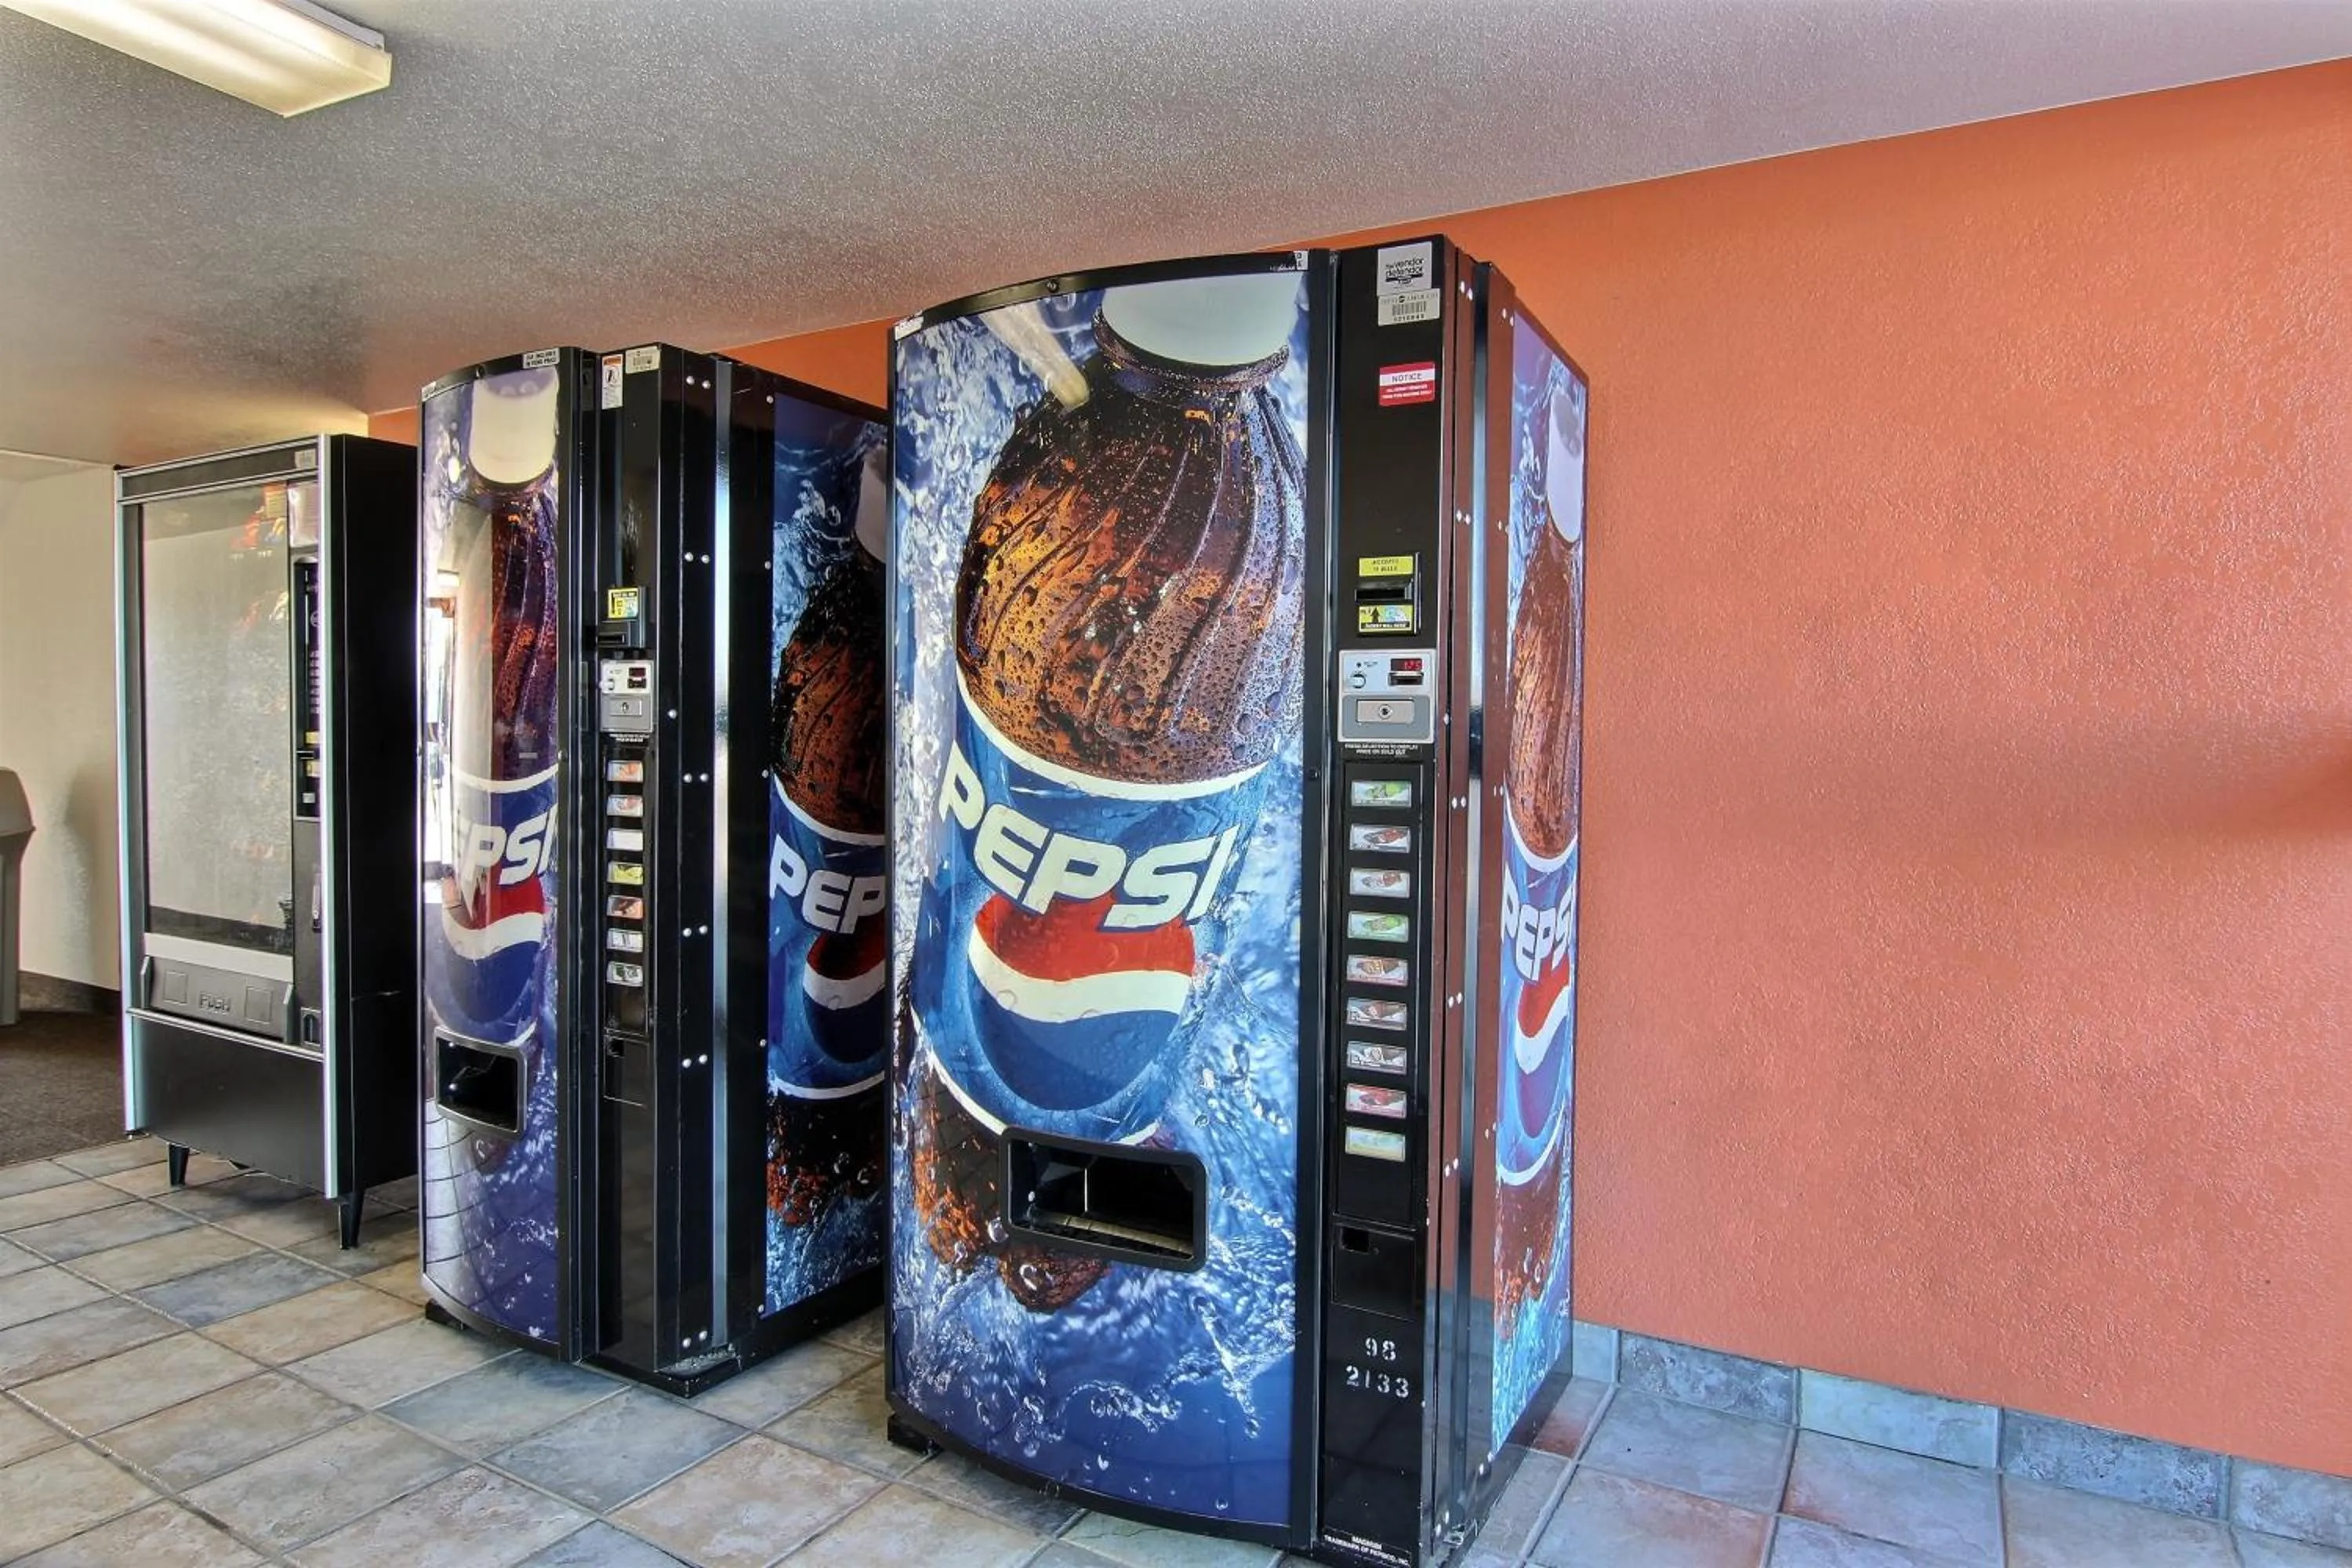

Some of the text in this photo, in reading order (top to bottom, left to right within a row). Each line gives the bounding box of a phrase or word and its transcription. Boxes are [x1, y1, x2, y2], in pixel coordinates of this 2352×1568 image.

[1392, 373, 1422, 383] NOTICE
[939, 739, 1240, 927] PEPSI
[769, 833, 887, 935] PEP
[199, 991, 231, 1013] PUSH
[1365, 1338, 1396, 1361] 98
[1345, 1365, 1409, 1398] 2133
